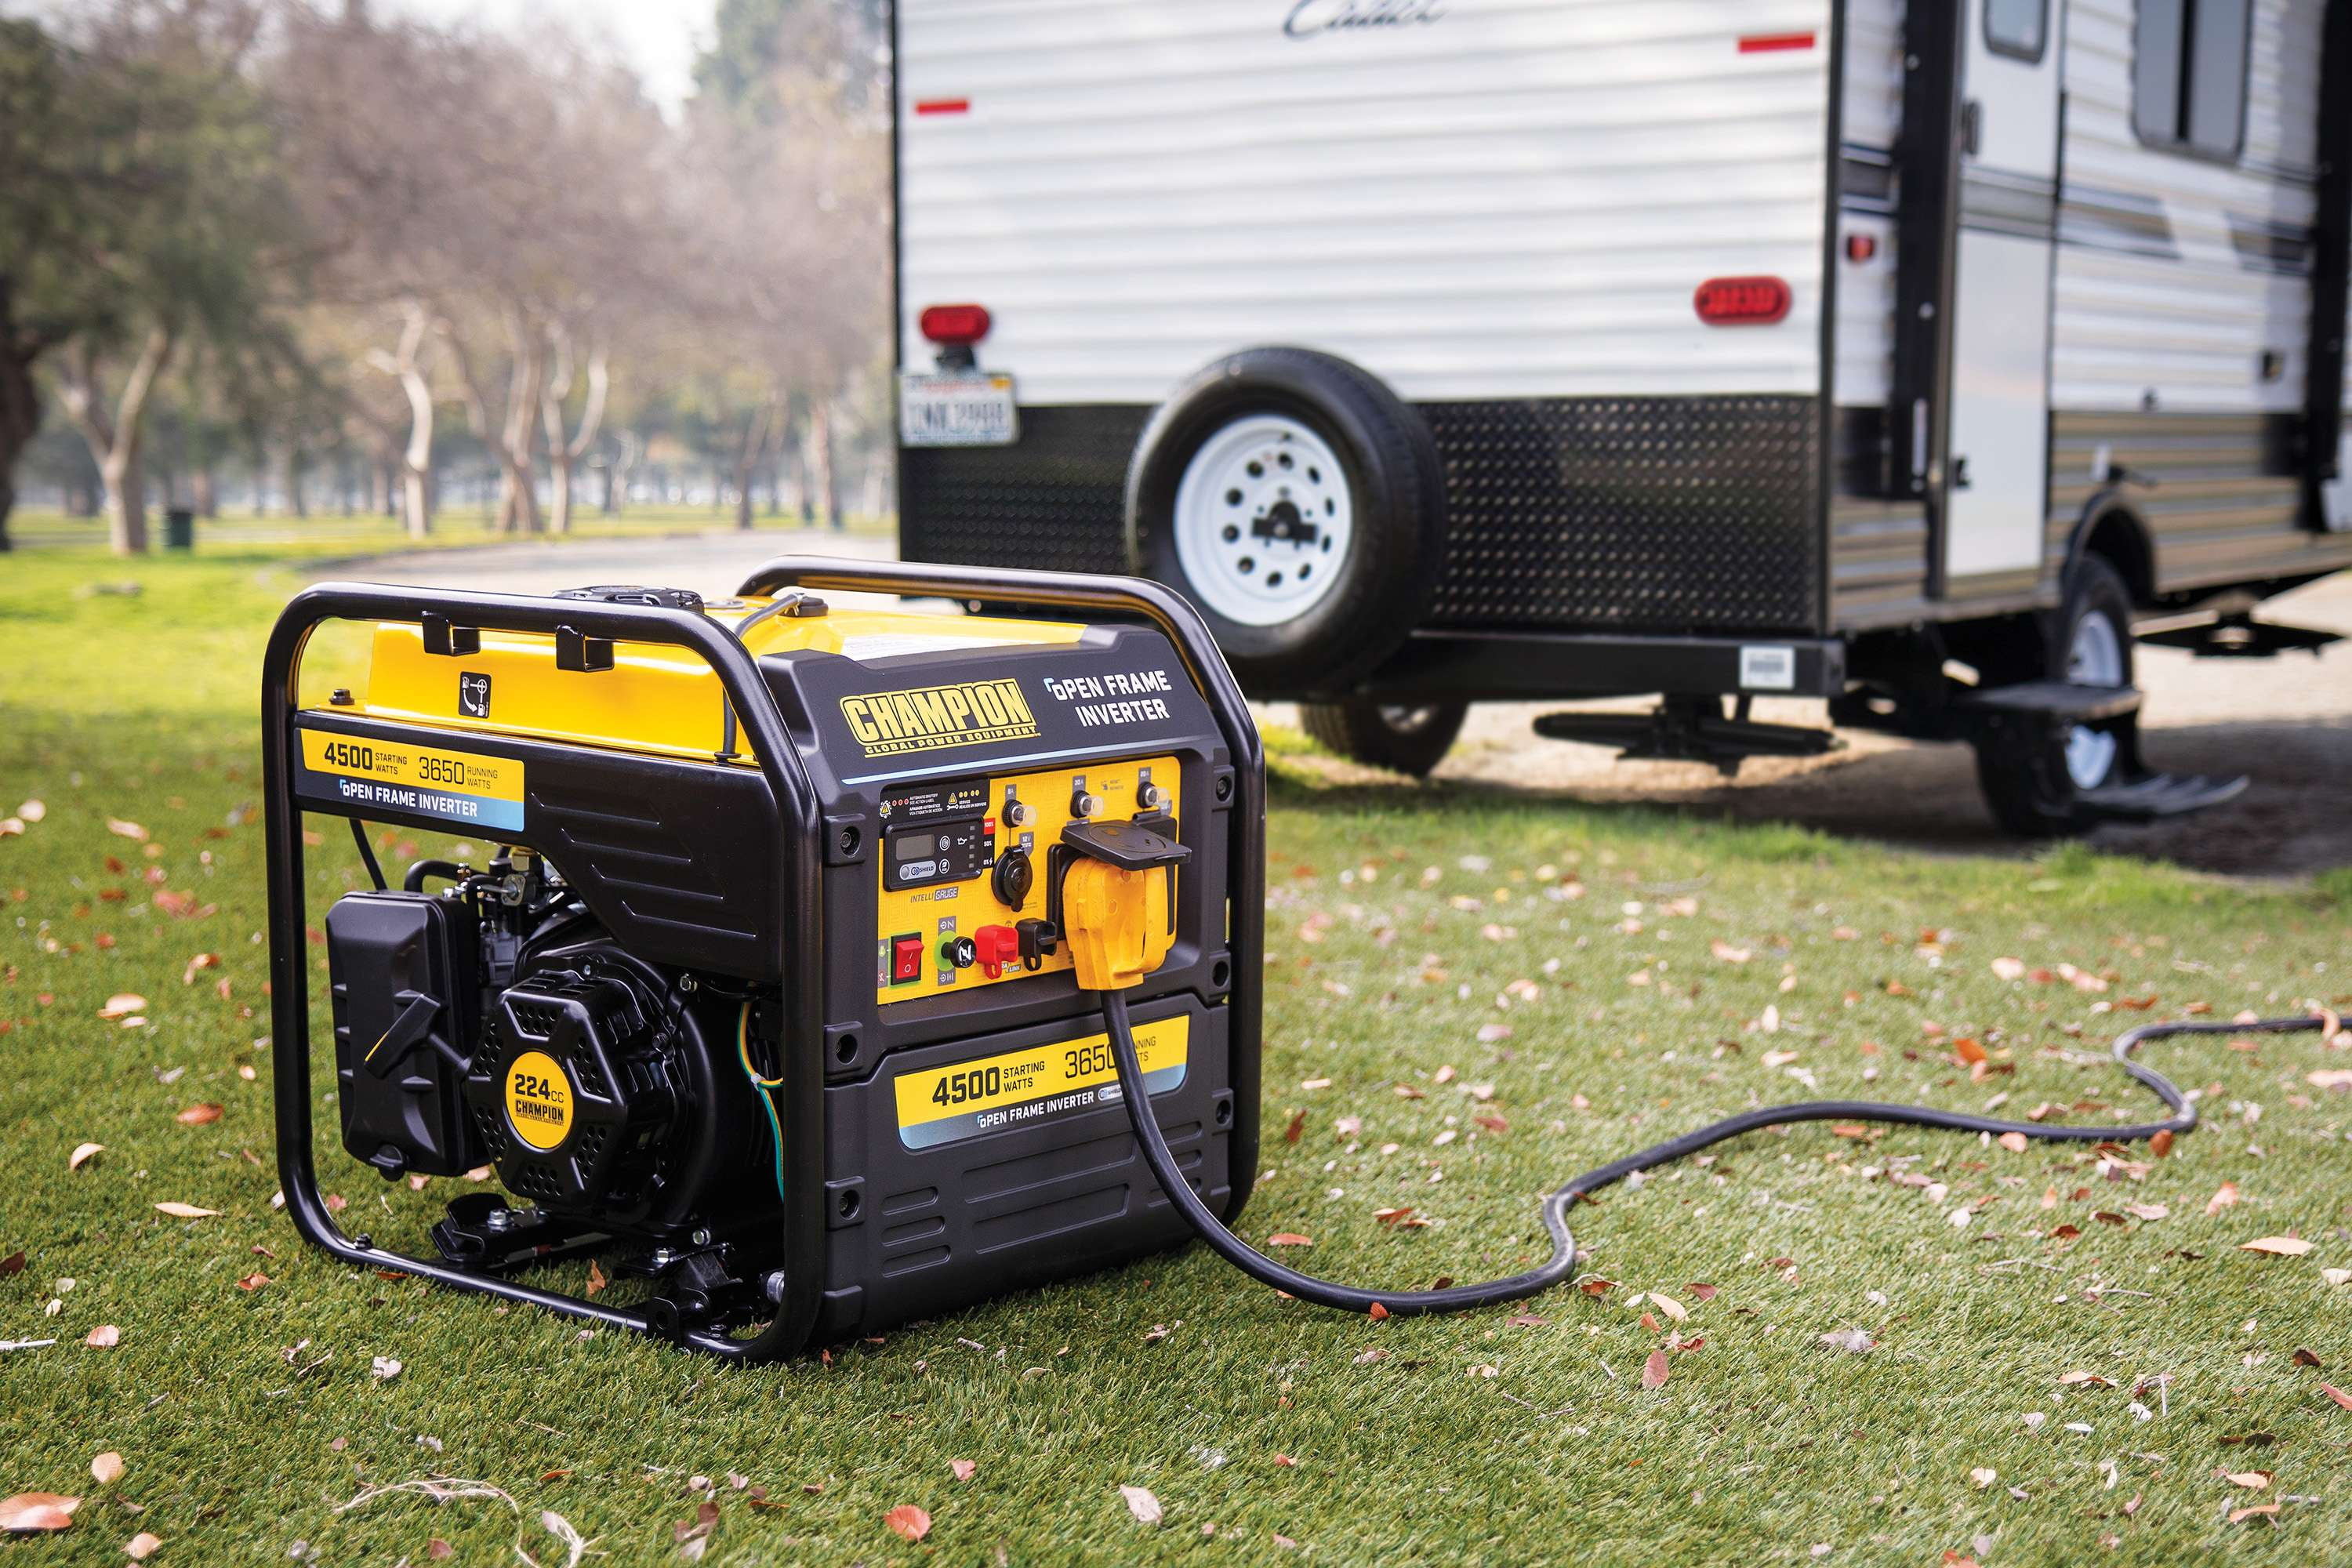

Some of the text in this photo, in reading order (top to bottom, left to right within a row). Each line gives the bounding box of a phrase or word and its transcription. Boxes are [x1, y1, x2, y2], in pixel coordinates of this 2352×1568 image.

[1044, 670, 1172, 701] OPEN FRAME
[842, 680, 1034, 743] CHAMPION
[1075, 699, 1171, 728] INVERTER
[866, 726, 1036, 754] GLOBAL POWER EQUIPMENT
[324, 742, 373, 771] 4500
[376, 752, 408, 765] STARTING
[376, 764, 398, 775] WATTS
[419, 757, 465, 786] 3650
[467, 766, 498, 779] RUNNING
[467, 777, 491, 789] WATTS
[339, 779, 478, 817] OPEN FRAME INVERTER
[1004, 1061, 1045, 1079] STARTING
[932, 1066, 1000, 1106] 4500
[1004, 1077, 1033, 1092] WATTS
[515, 1099, 564, 1121] CHAMPION
[977, 1111, 1007, 1128] OPEN
[1010, 1102, 1044, 1121] FRAME
[1047, 1091, 1094, 1113] INVERTER
